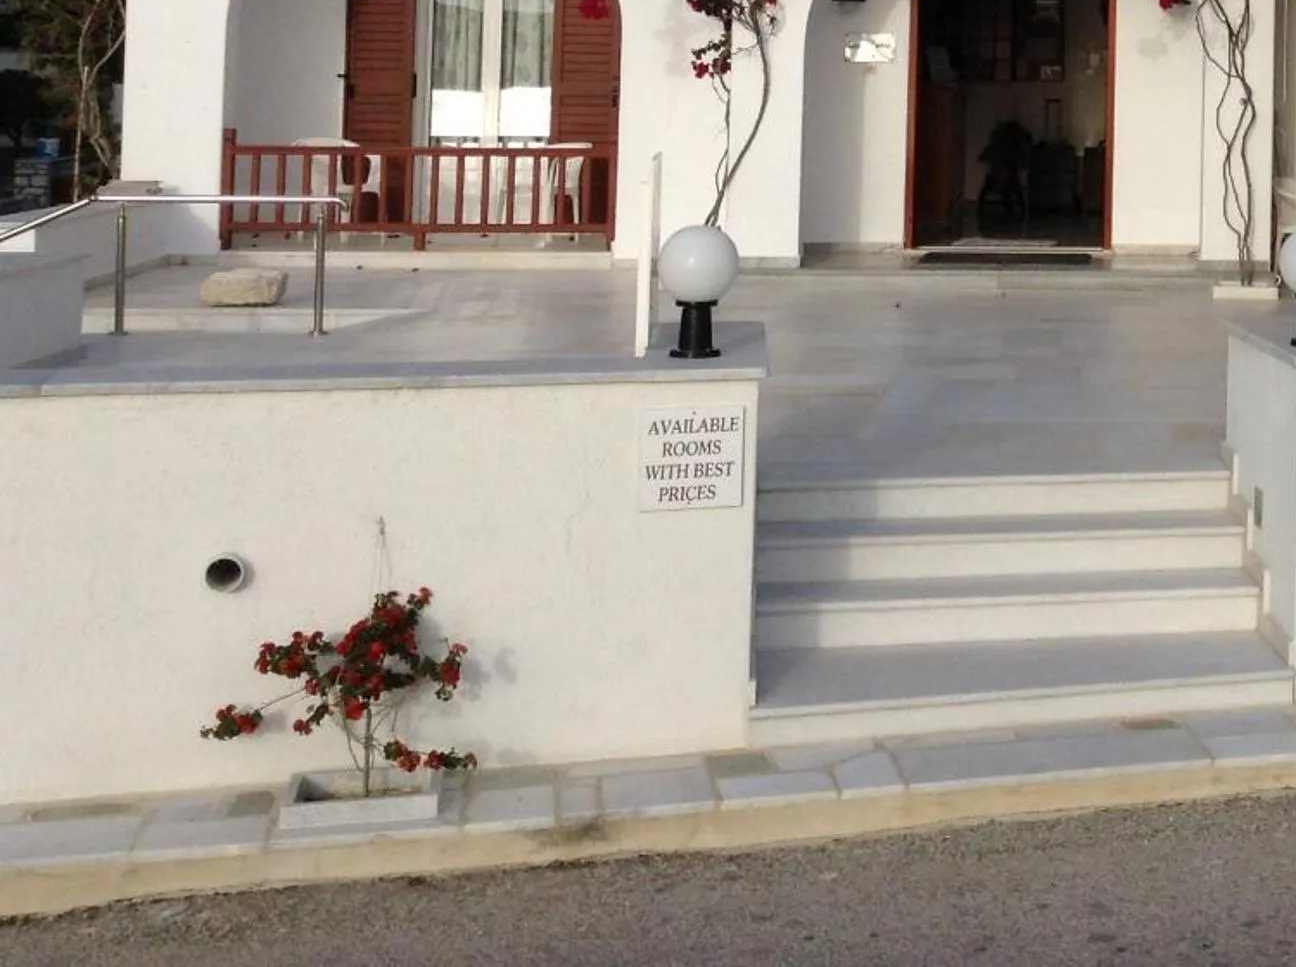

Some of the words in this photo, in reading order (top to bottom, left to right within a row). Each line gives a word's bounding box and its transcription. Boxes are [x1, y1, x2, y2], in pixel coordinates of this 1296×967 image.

[647, 416, 740, 436] AVAILABLE
[662, 439, 722, 458] ROOMS
[645, 463, 690, 481] WITH
[693, 461, 735, 479] BEST
[658, 484, 717, 502] PRICES
